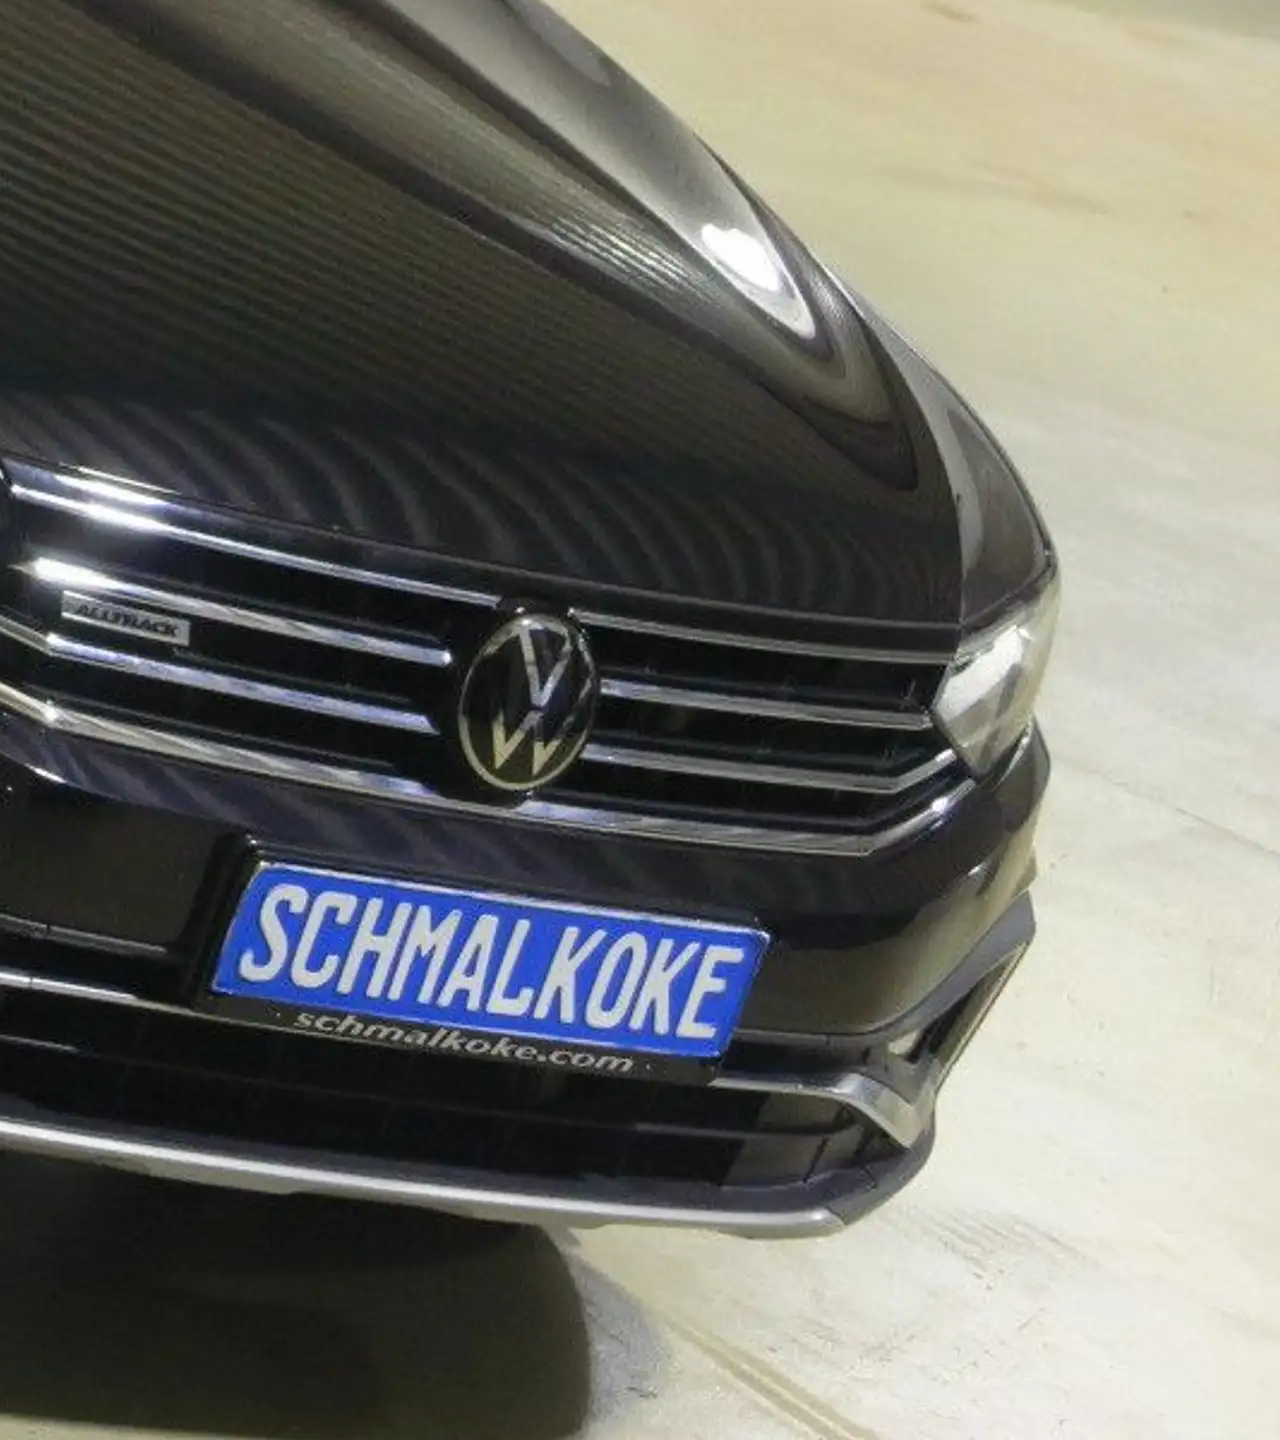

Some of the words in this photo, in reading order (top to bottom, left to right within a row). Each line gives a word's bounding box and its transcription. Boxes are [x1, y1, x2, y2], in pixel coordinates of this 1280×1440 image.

[460, 617, 594, 788] VW
[239, 884, 744, 1040] SCHMALKOKE
[294, 1010, 635, 1074] schmalkoke.com
